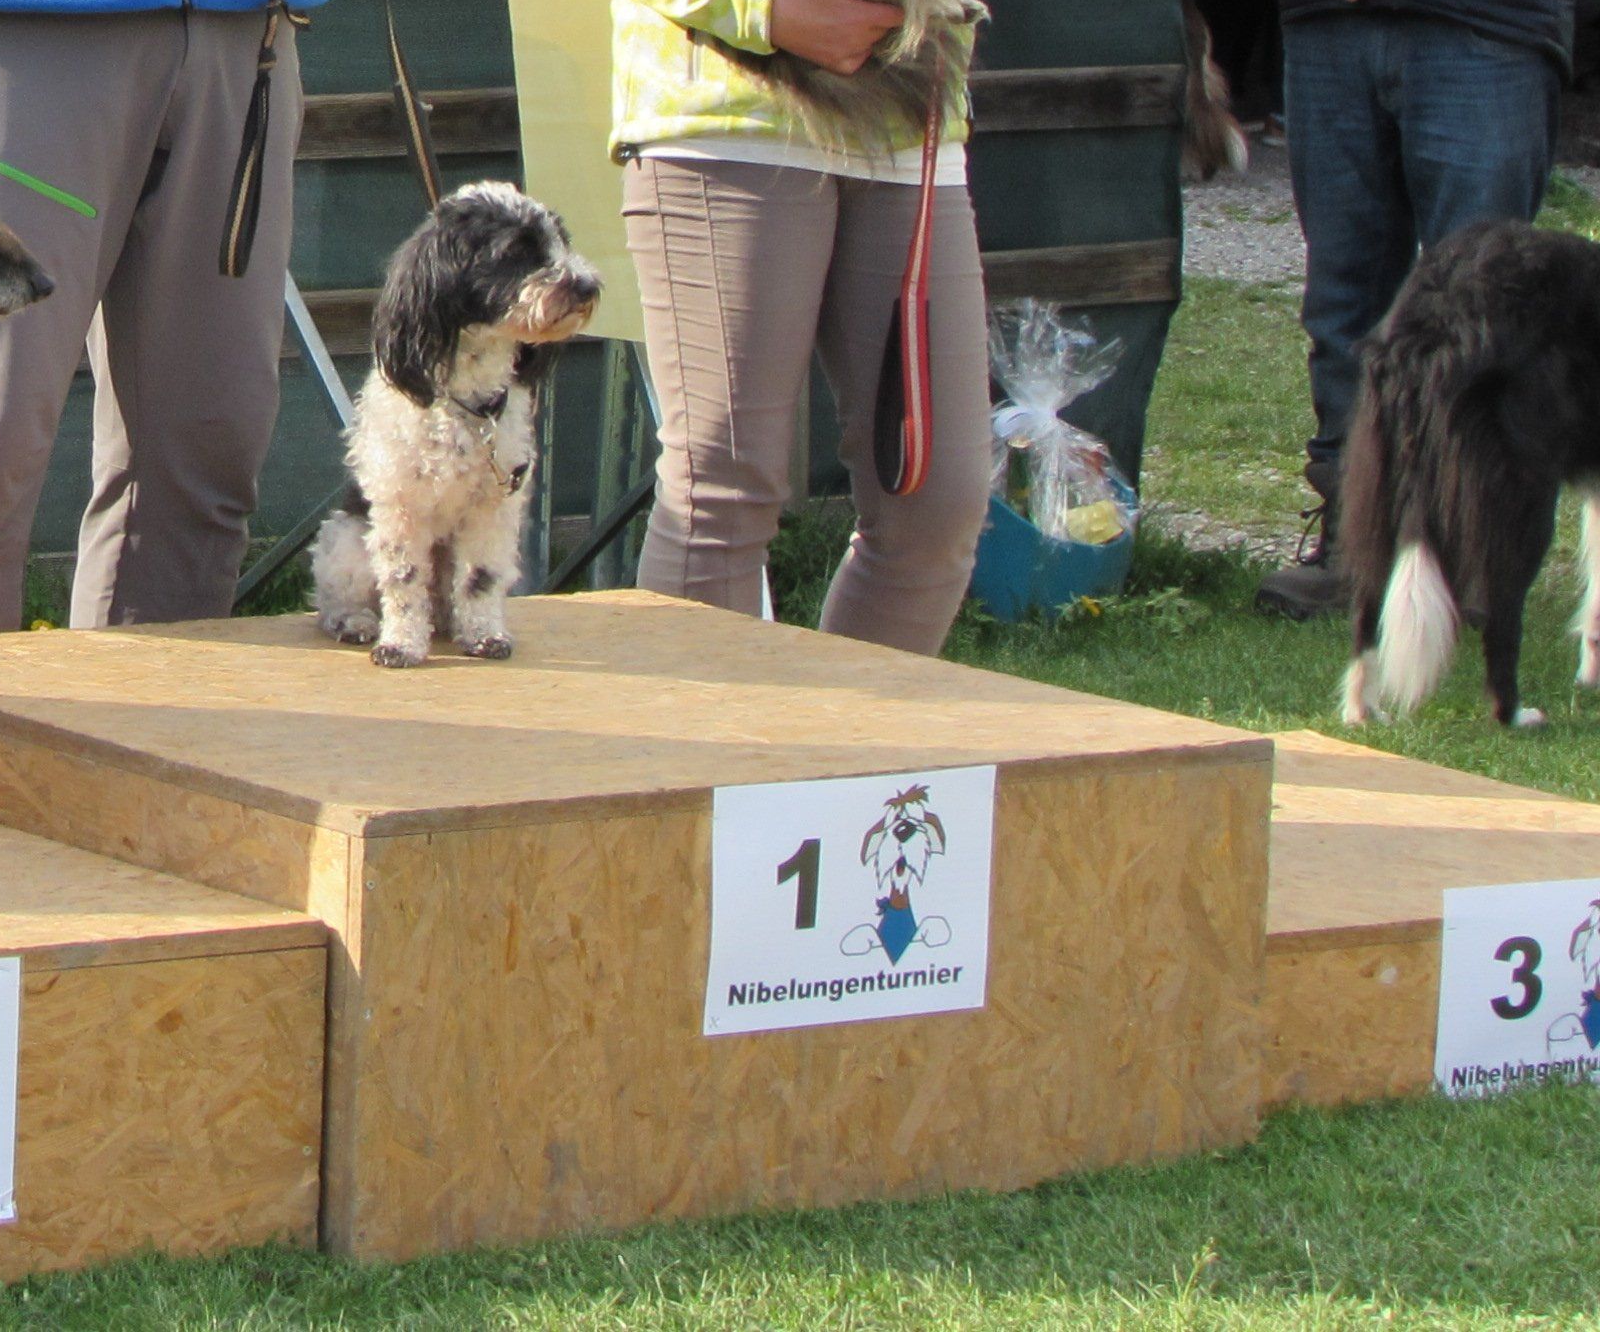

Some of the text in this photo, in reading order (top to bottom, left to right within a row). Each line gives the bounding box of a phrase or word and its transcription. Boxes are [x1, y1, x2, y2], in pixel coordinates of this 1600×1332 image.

[777, 838, 821, 930] 1
[728, 964, 963, 1007] Nibelungenturnier
[1490, 936, 1543, 1020] 3
